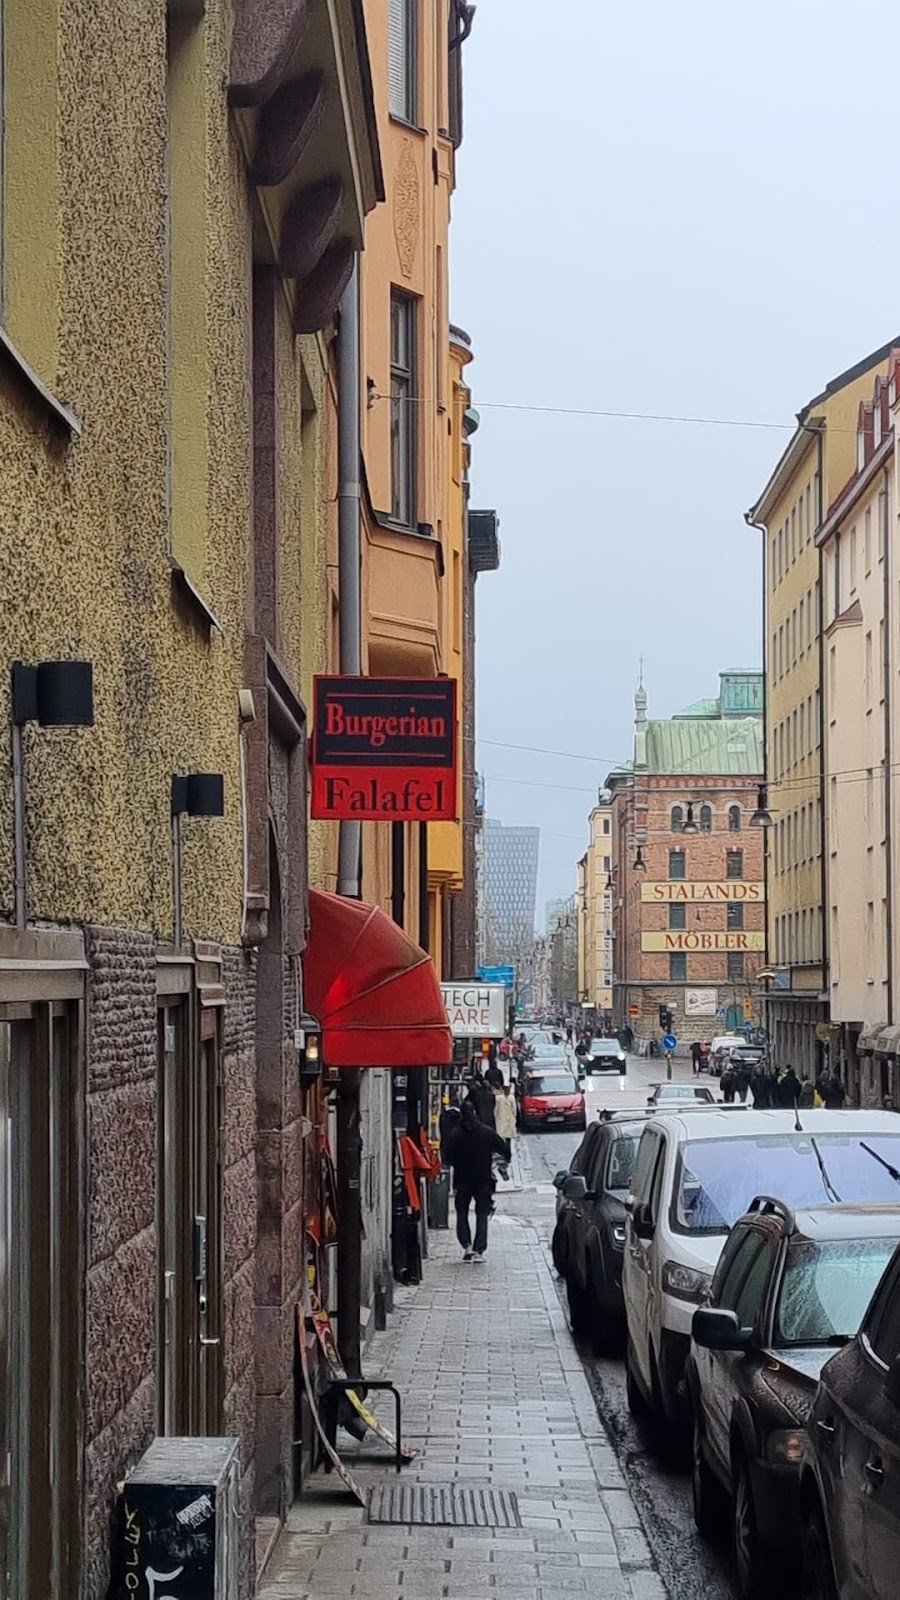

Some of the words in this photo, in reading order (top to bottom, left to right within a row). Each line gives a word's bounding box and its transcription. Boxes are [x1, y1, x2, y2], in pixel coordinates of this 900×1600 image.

[324, 702, 447, 747] Burgerian
[324, 777, 446, 812] Falafel
[654, 884, 760, 900] STALANDS
[664, 930, 749, 949] MÖBLER
[446, 1008, 490, 1026] ARE
